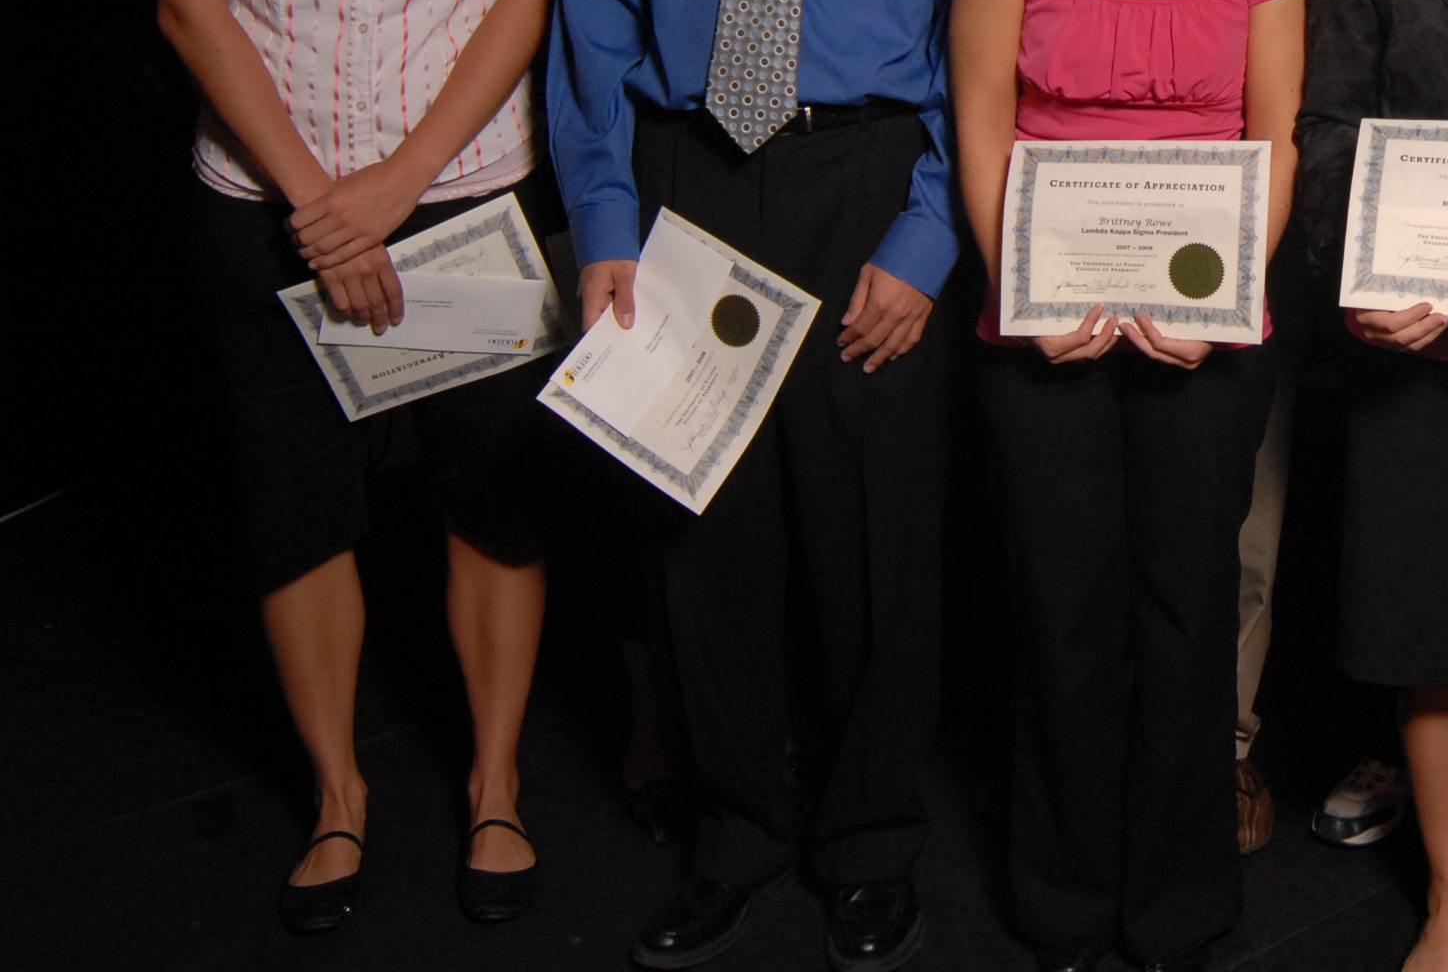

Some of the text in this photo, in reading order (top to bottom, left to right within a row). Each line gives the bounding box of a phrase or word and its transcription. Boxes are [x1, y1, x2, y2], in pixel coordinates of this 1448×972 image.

[1050, 179, 1121, 189] CERTIFICATE
[1144, 181, 1225, 192] APPRECIATION
[1098, 217, 1173, 228] Brittney Rowe
[1133, 229, 1154, 237] Sigma
[372, 351, 445, 380] APPRECIATION
